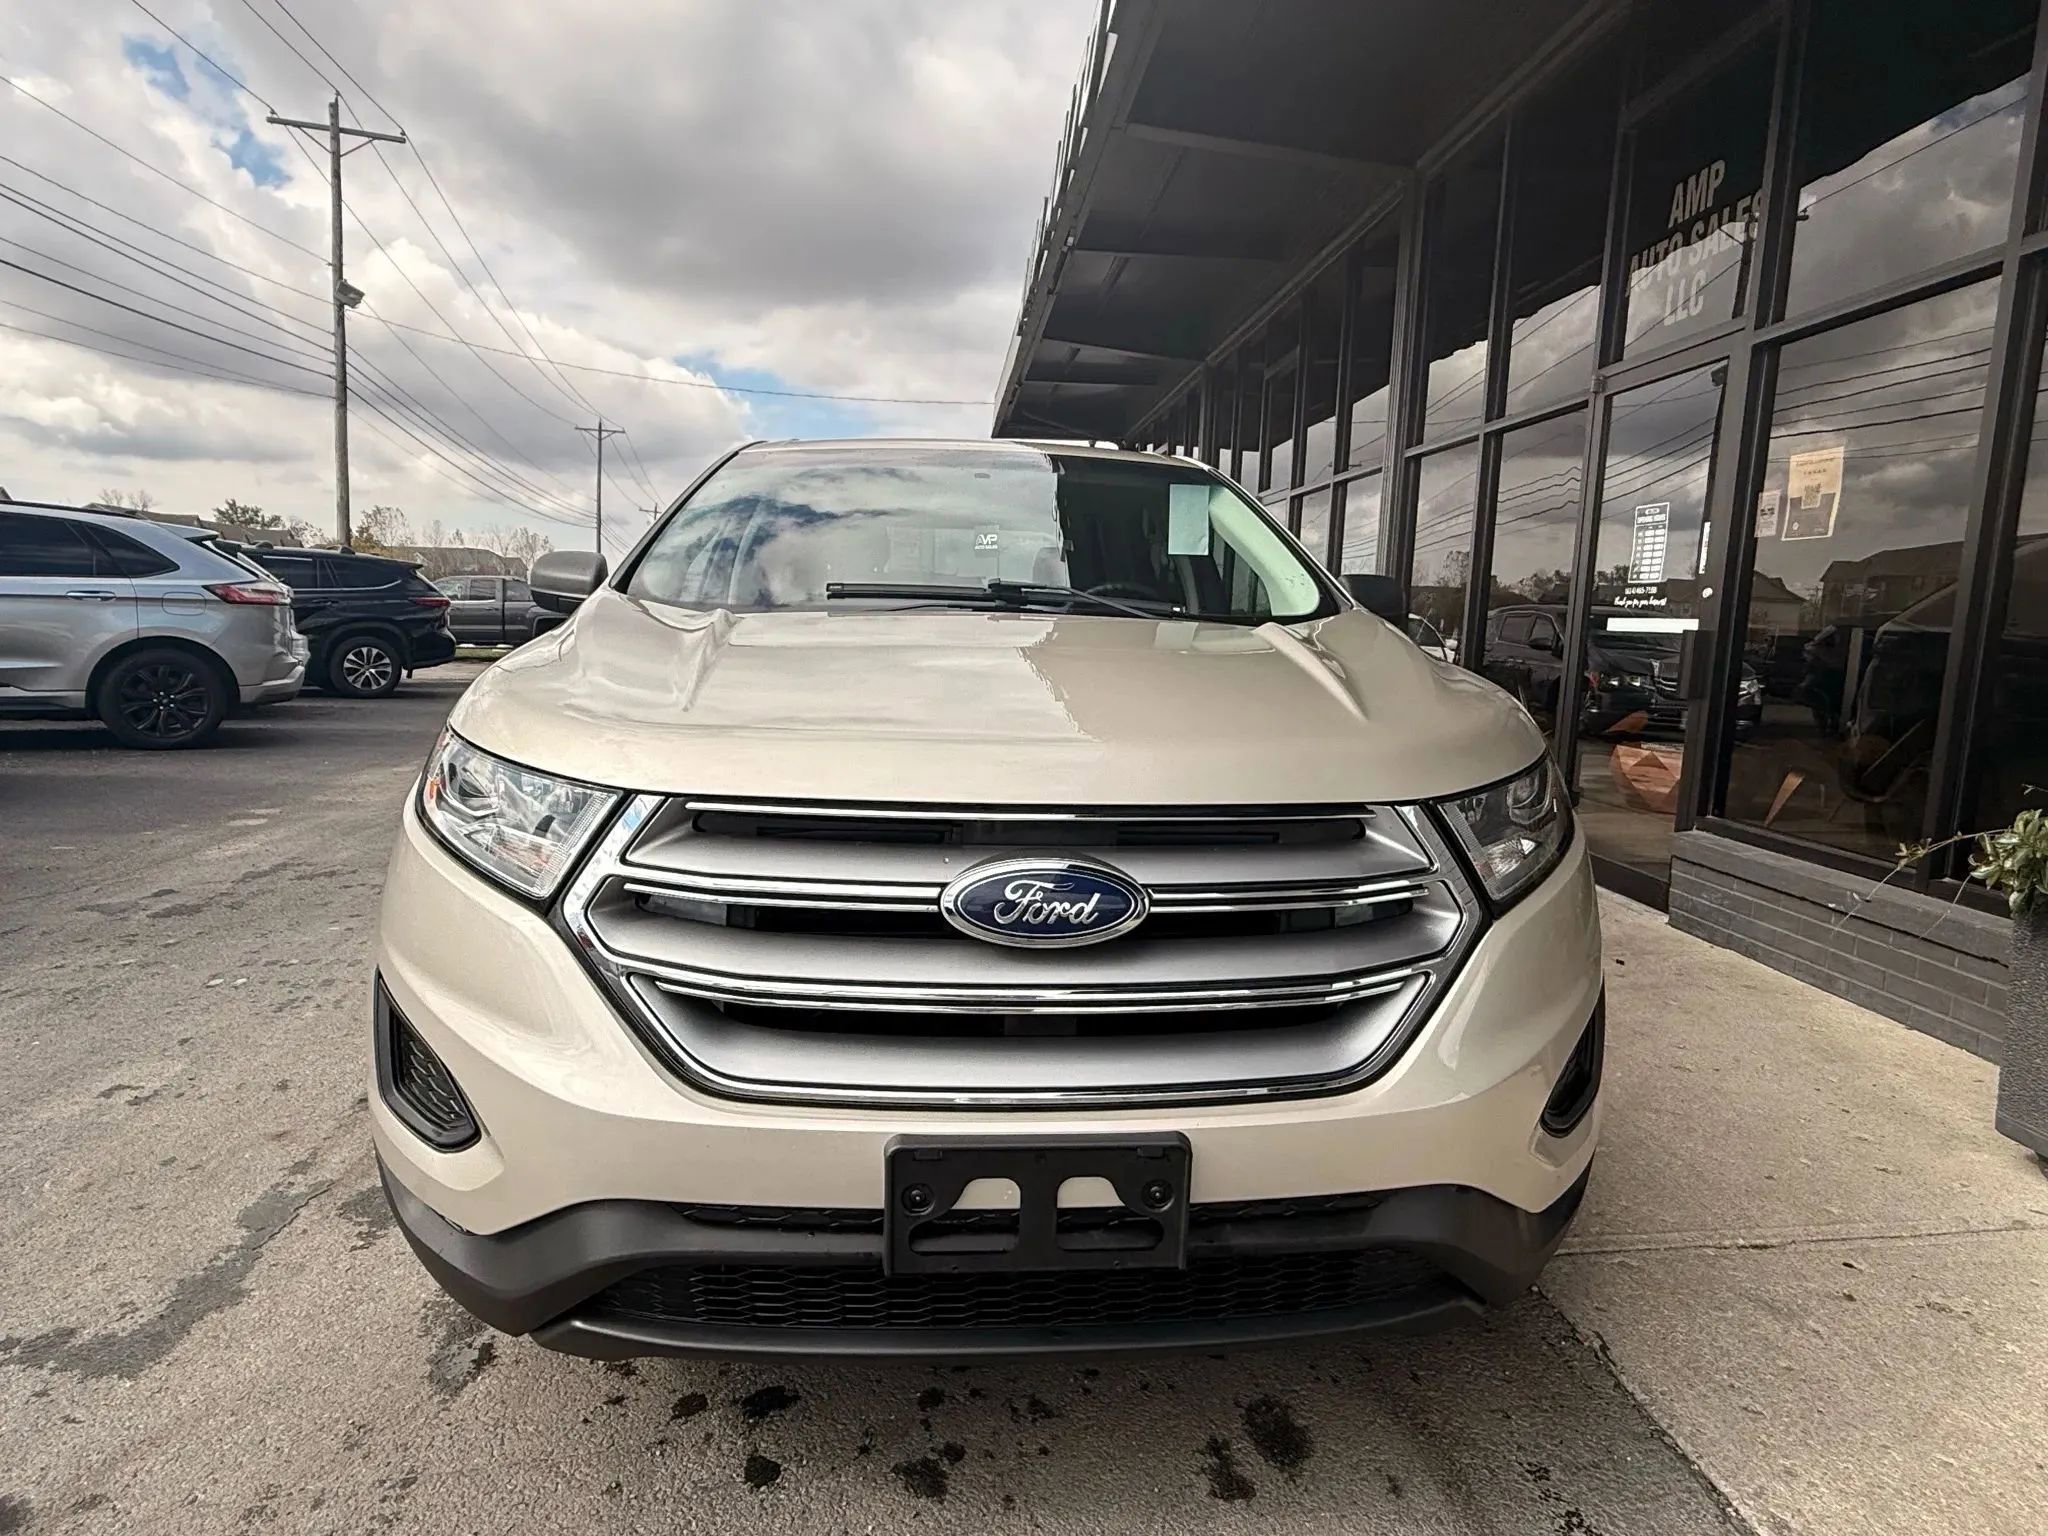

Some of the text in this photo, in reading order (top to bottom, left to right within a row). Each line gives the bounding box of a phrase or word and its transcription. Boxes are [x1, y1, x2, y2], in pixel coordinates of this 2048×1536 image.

[1668, 159, 1726, 229] AMP
[1625, 188, 1763, 298] AUTO SALES
[1664, 270, 1708, 326] LLC
[994, 879, 1100, 925] Ford
